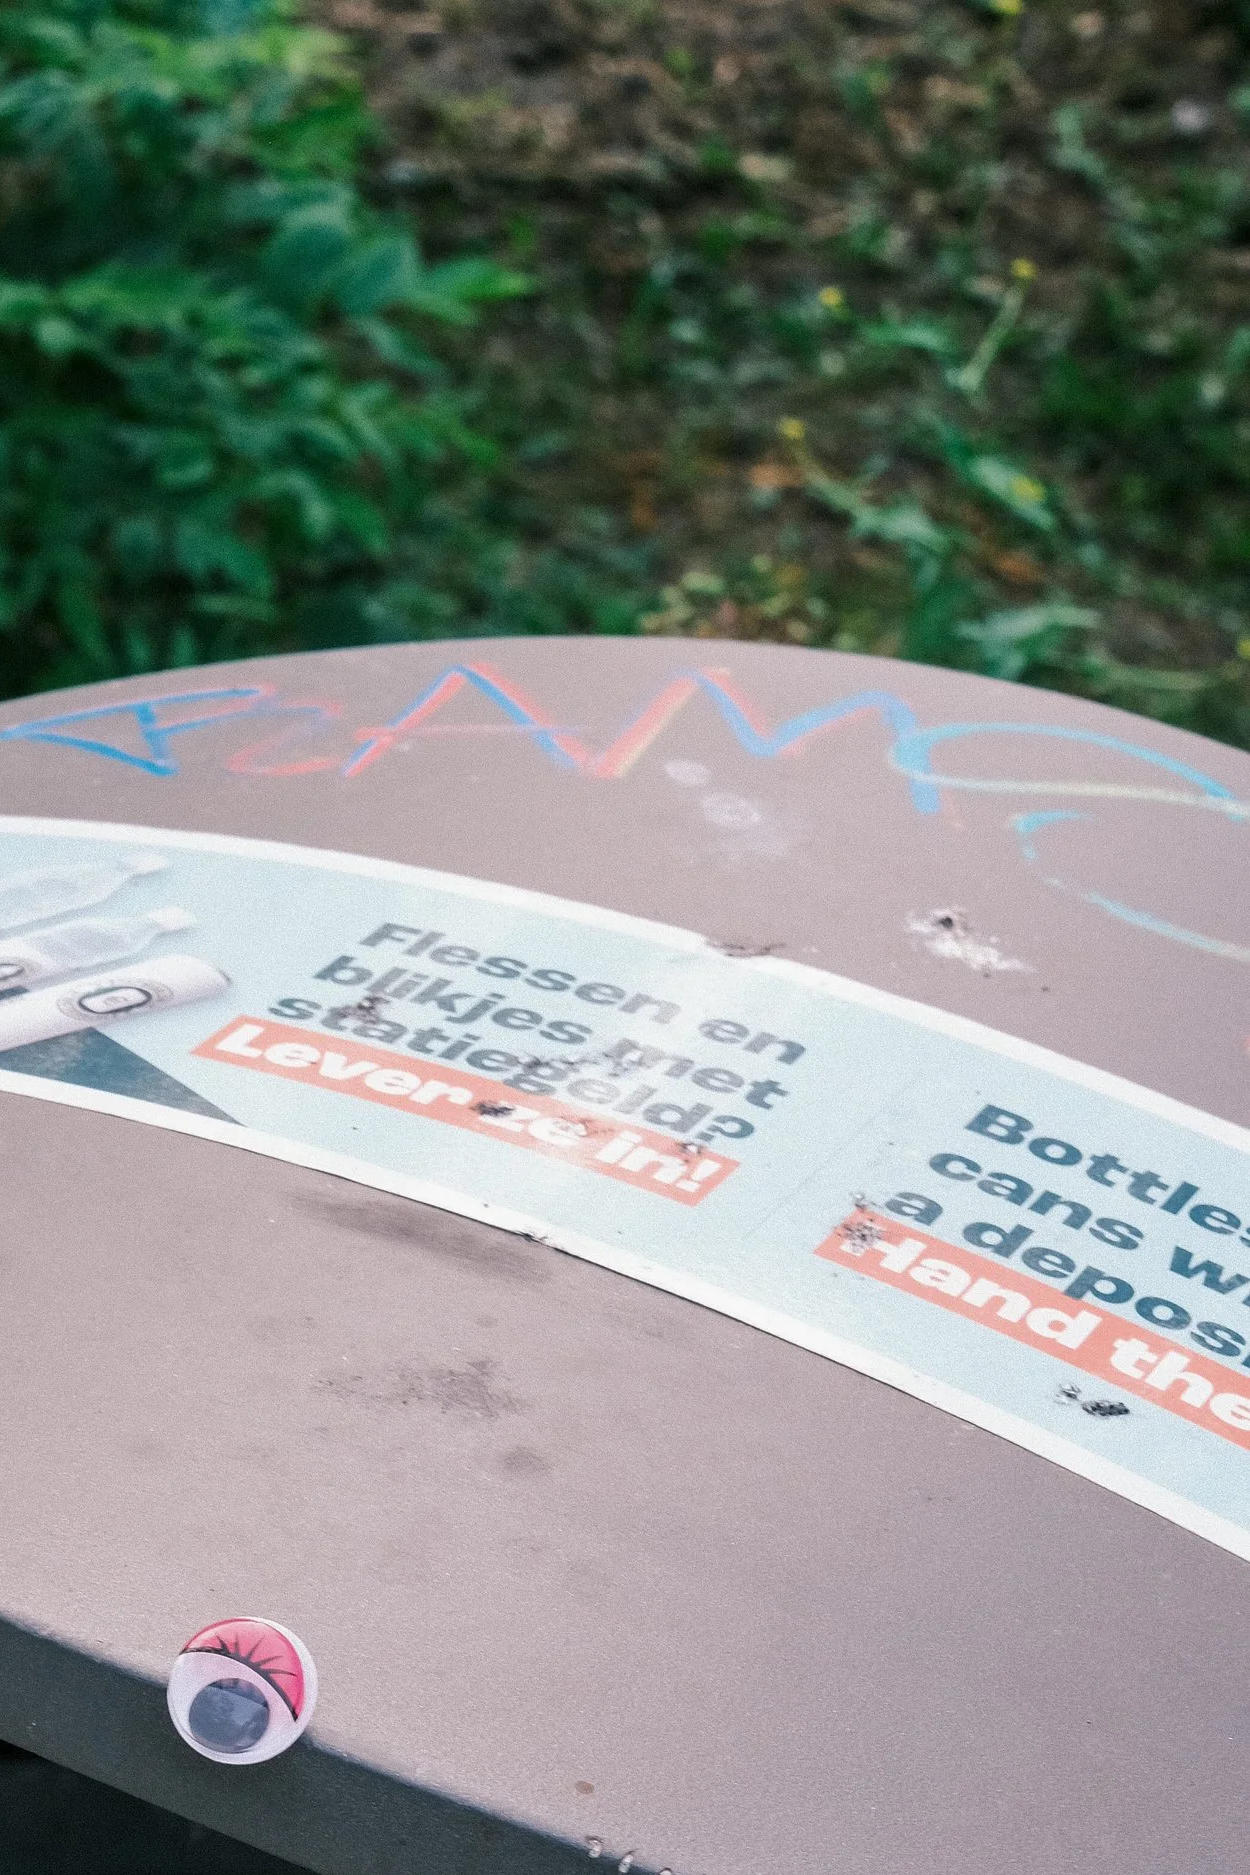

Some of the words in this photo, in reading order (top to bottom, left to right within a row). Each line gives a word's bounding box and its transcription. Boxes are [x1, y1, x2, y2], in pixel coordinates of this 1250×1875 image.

[313, 955, 593, 1045] blikjes
[603, 1037, 789, 1110] met
[359, 922, 681, 1024] Flessen
[699, 1018, 806, 1065] en
[214, 1023, 474, 1105] Lever
[596, 1131, 723, 1192] in!
[268, 998, 755, 1142] statiegeld?
[929, 1152, 1145, 1250] cans
[965, 1104, 1250, 1244] Bottle
[839, 1222, 1102, 1349] Hand
[886, 1192, 943, 1226] a
[963, 1222, 1250, 1368] depos
